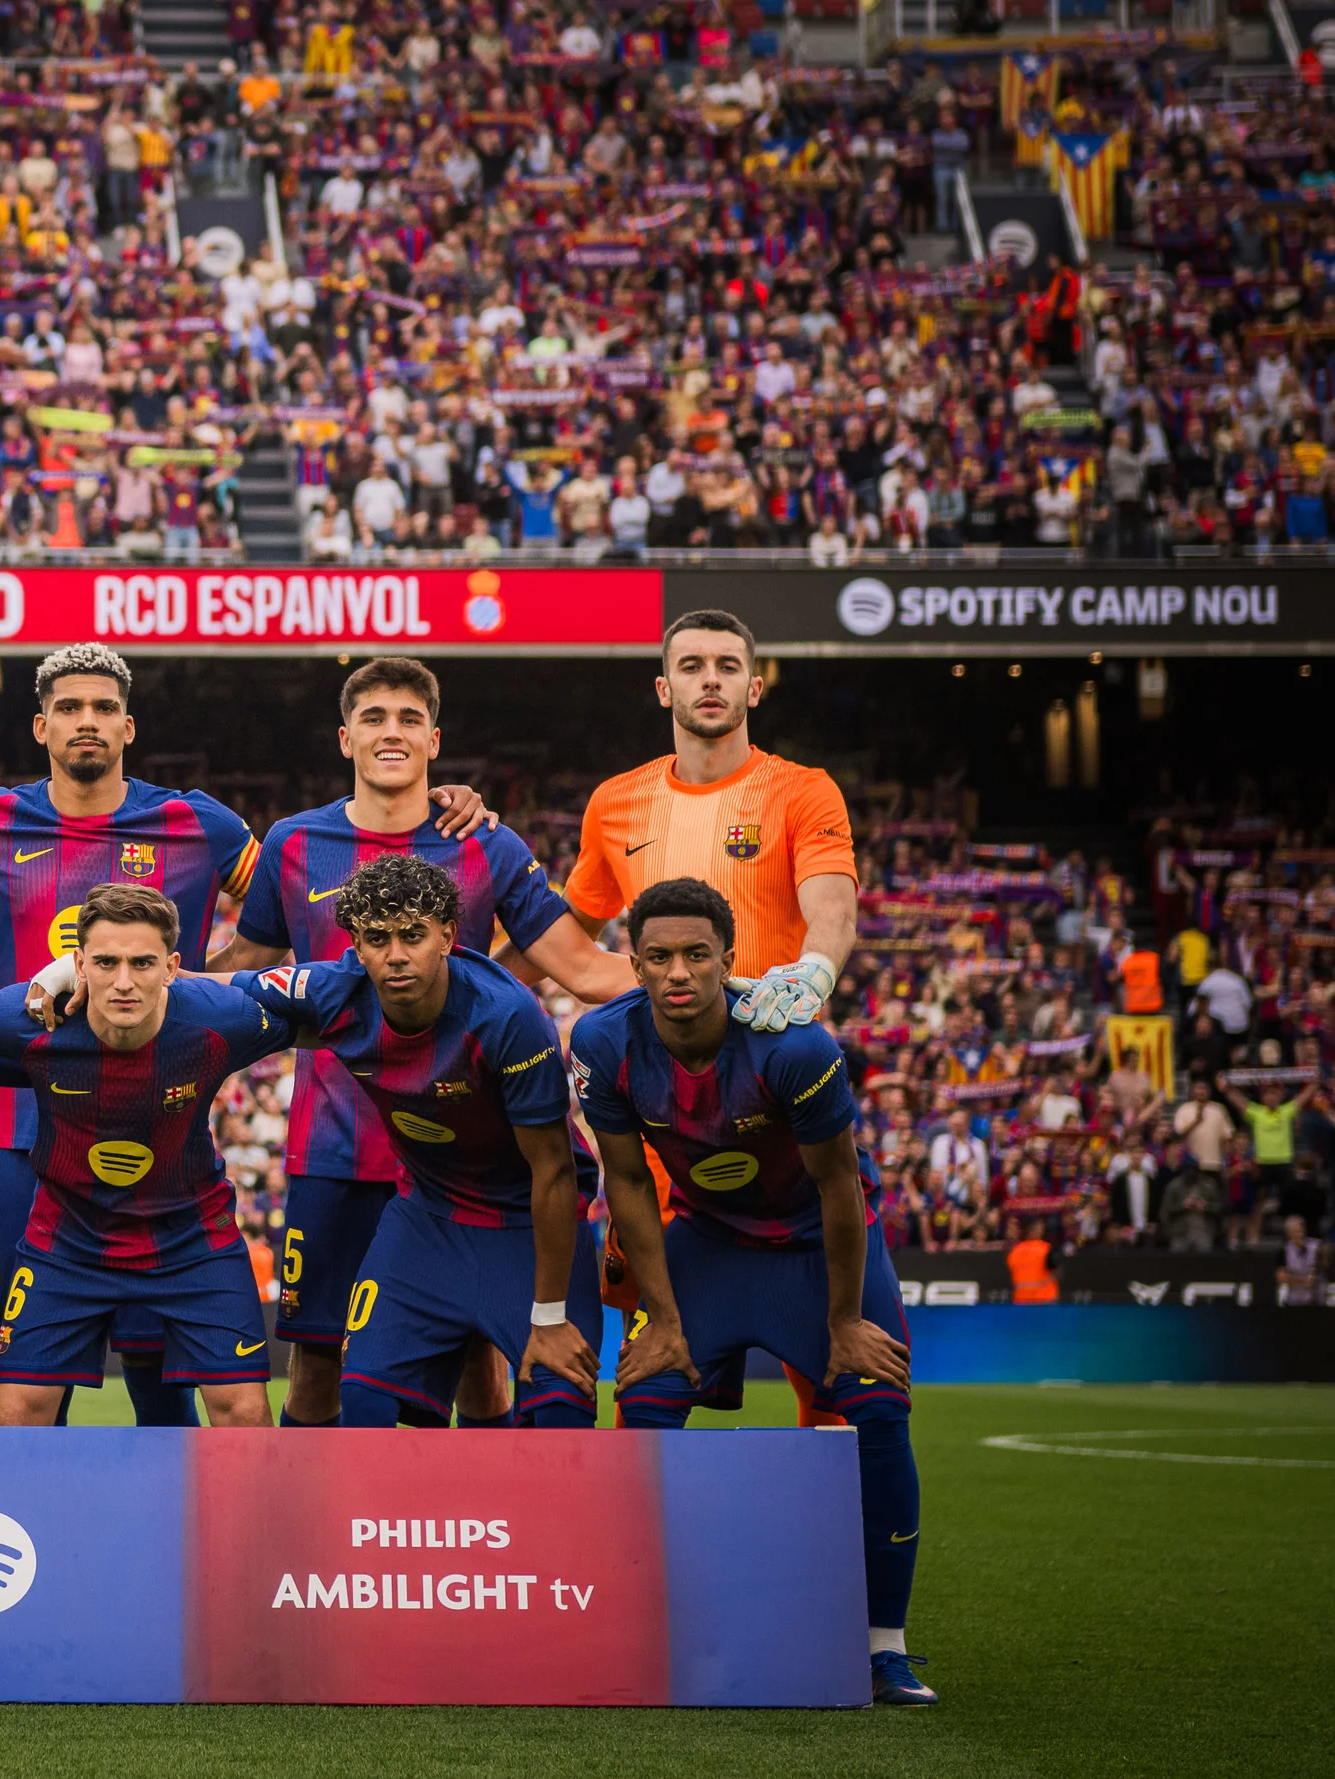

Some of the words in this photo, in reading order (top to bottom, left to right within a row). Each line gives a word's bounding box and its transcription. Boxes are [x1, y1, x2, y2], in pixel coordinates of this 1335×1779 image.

[94, 575, 187, 636] RCD
[197, 575, 431, 636] ESPANYOL
[900, 586, 1064, 626] SPOTIFY
[1071, 586, 1186, 626] CAMP
[1194, 585, 1278, 625] NOU
[503, 1049, 548, 1074] AMBILIGHT
[793, 1063, 837, 1105] AMBILIGHT
[283, 1227, 304, 1284] 5
[3, 1266, 34, 1320] 6
[351, 1518, 511, 1549] PHILIPS
[271, 1573, 537, 1610] AMBILIGHT
[550, 1577, 594, 1611] tv
